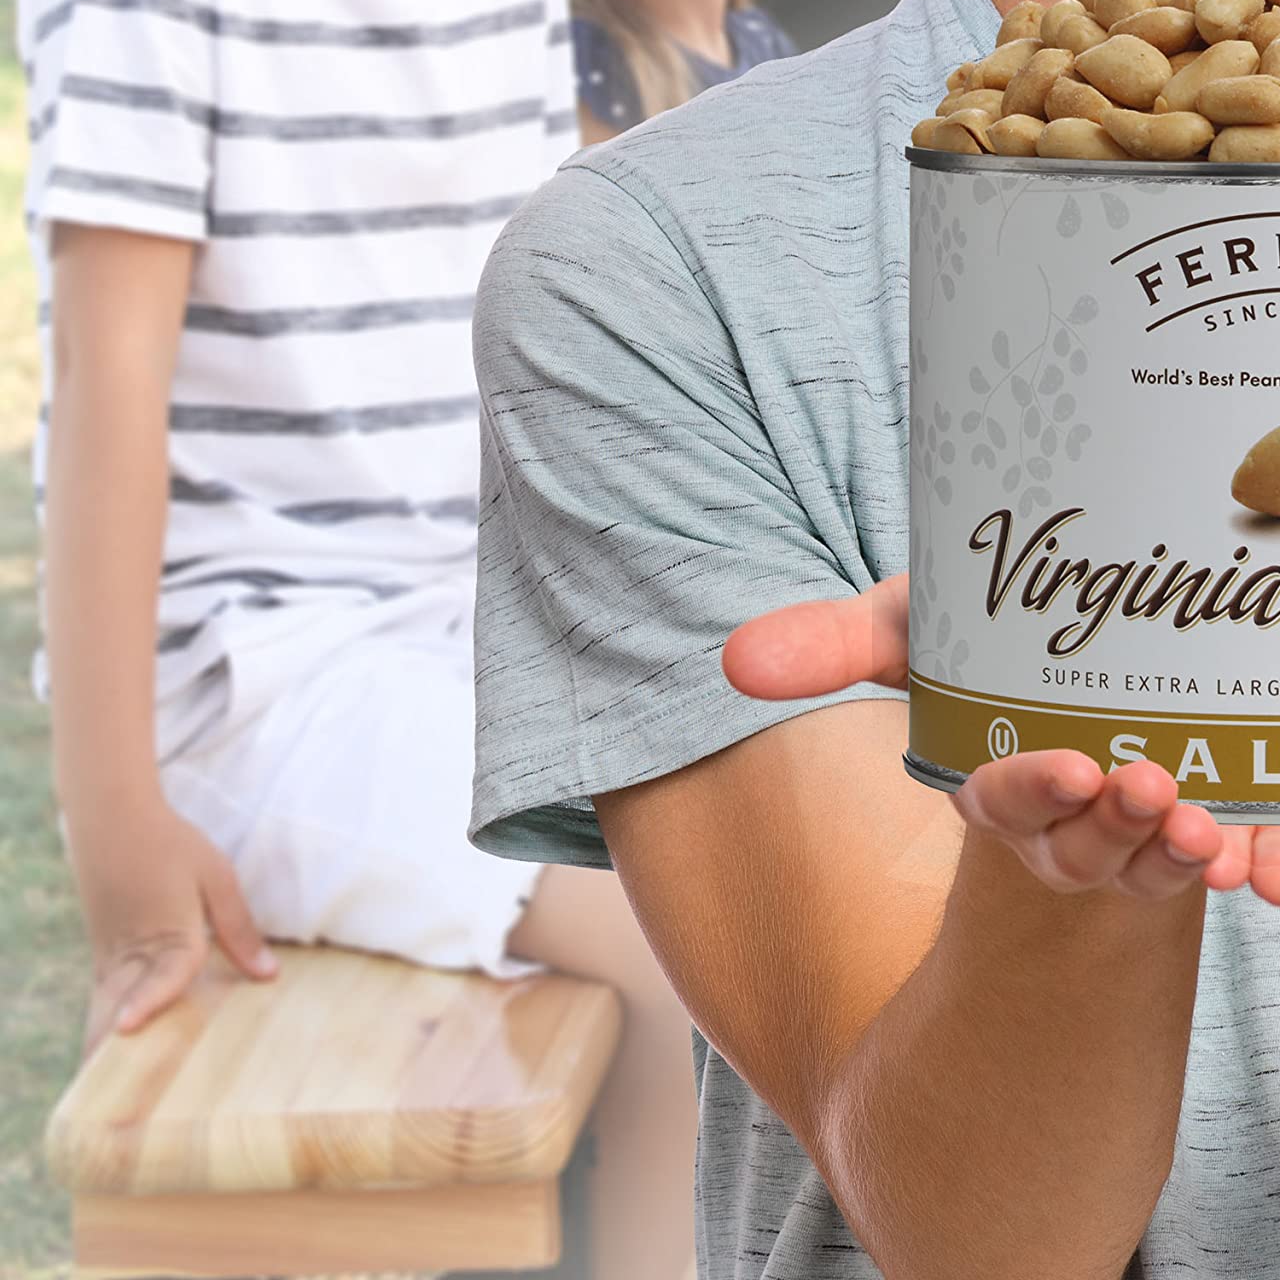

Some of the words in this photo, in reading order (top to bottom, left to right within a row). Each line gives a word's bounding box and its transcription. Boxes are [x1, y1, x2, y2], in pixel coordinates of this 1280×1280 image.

[1131, 368, 1193, 387] World's
[1199, 370, 1234, 387] Best
[1041, 666, 1110, 690] SUPER
[1125, 674, 1199, 695] EXTRA
